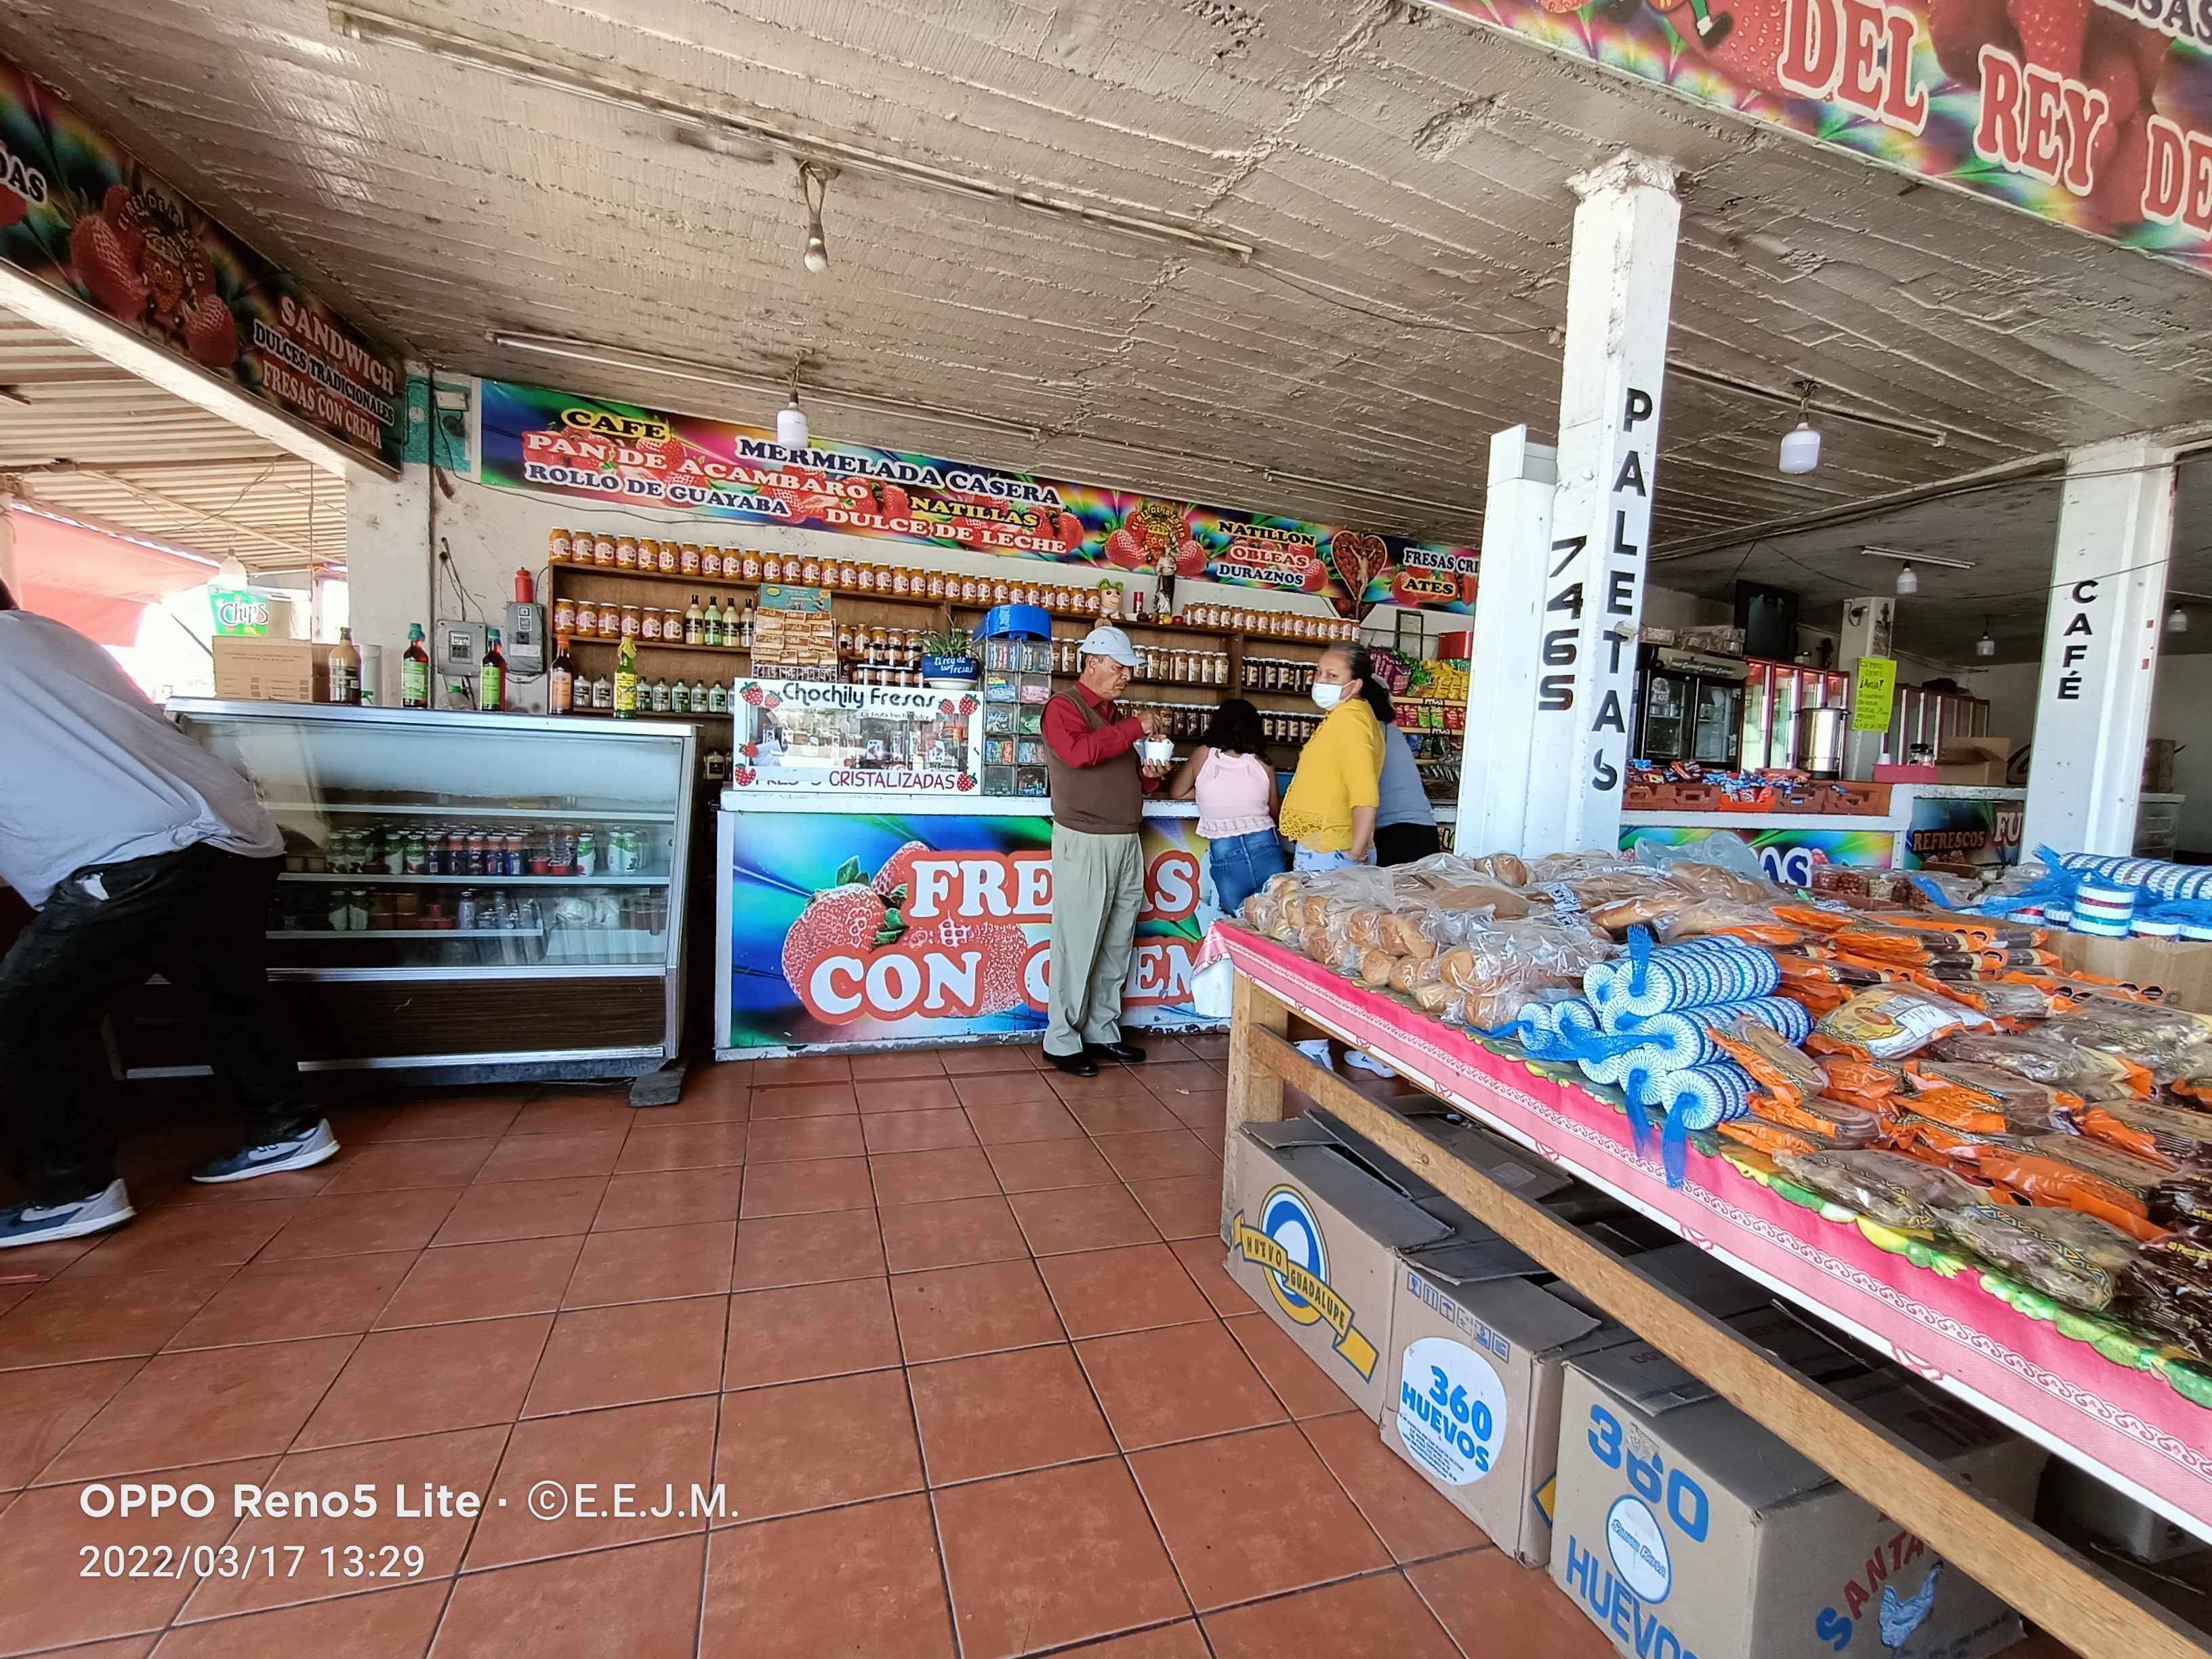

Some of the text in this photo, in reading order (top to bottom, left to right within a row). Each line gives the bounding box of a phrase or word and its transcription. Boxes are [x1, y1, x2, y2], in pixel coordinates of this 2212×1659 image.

[1780, 0, 1923, 130] DEL
[1982, 47, 2106, 192] REY
[255, 321, 394, 425] DULCES TRADICIONALES
[281, 295, 394, 396] SANDWICH
[262, 359, 382, 449] FRESAS CON CREMA
[565, 410, 668, 441] CAFE
[527, 434, 868, 499] PAN DE ACAMBARO
[527, 463, 789, 515] ROLLO DE GUAYABA
[739, 438, 1061, 505] MERMELADA CASERA
[825, 508, 1067, 554] DULCE DE LECHE
[910, 496, 1040, 528] NATILLAS
[1218, 521, 1316, 547] NATILLON
[1219, 563, 1305, 586] DURAZNOS
[1229, 546, 1310, 568] OBLEAS
[1404, 548, 1455, 571] FRESAS
[1404, 577, 1454, 596] ATES
[1592, 387, 1653, 792] PALETAS
[2057, 579, 2099, 701] CAFÉ
[782, 682, 936, 709] Chochily Fresas
[829, 770, 956, 791] CRISTALIZADAS
[1912, 830, 1985, 852] REFRESCOS
[909, 858, 1193, 919] FRES
[809, 951, 982, 1015] CON
[1246, 1236, 1282, 1268] HUEVO
[1290, 1269, 1345, 1330] GUADALUPE
[1401, 1381, 1490, 1473] HUEVOS
[1428, 1364, 1493, 1443] 360
[1587, 1404, 1709, 1543] 360
[1566, 1534, 1700, 1659] HUEVO
[1815, 1530, 1925, 1652] SANTA
